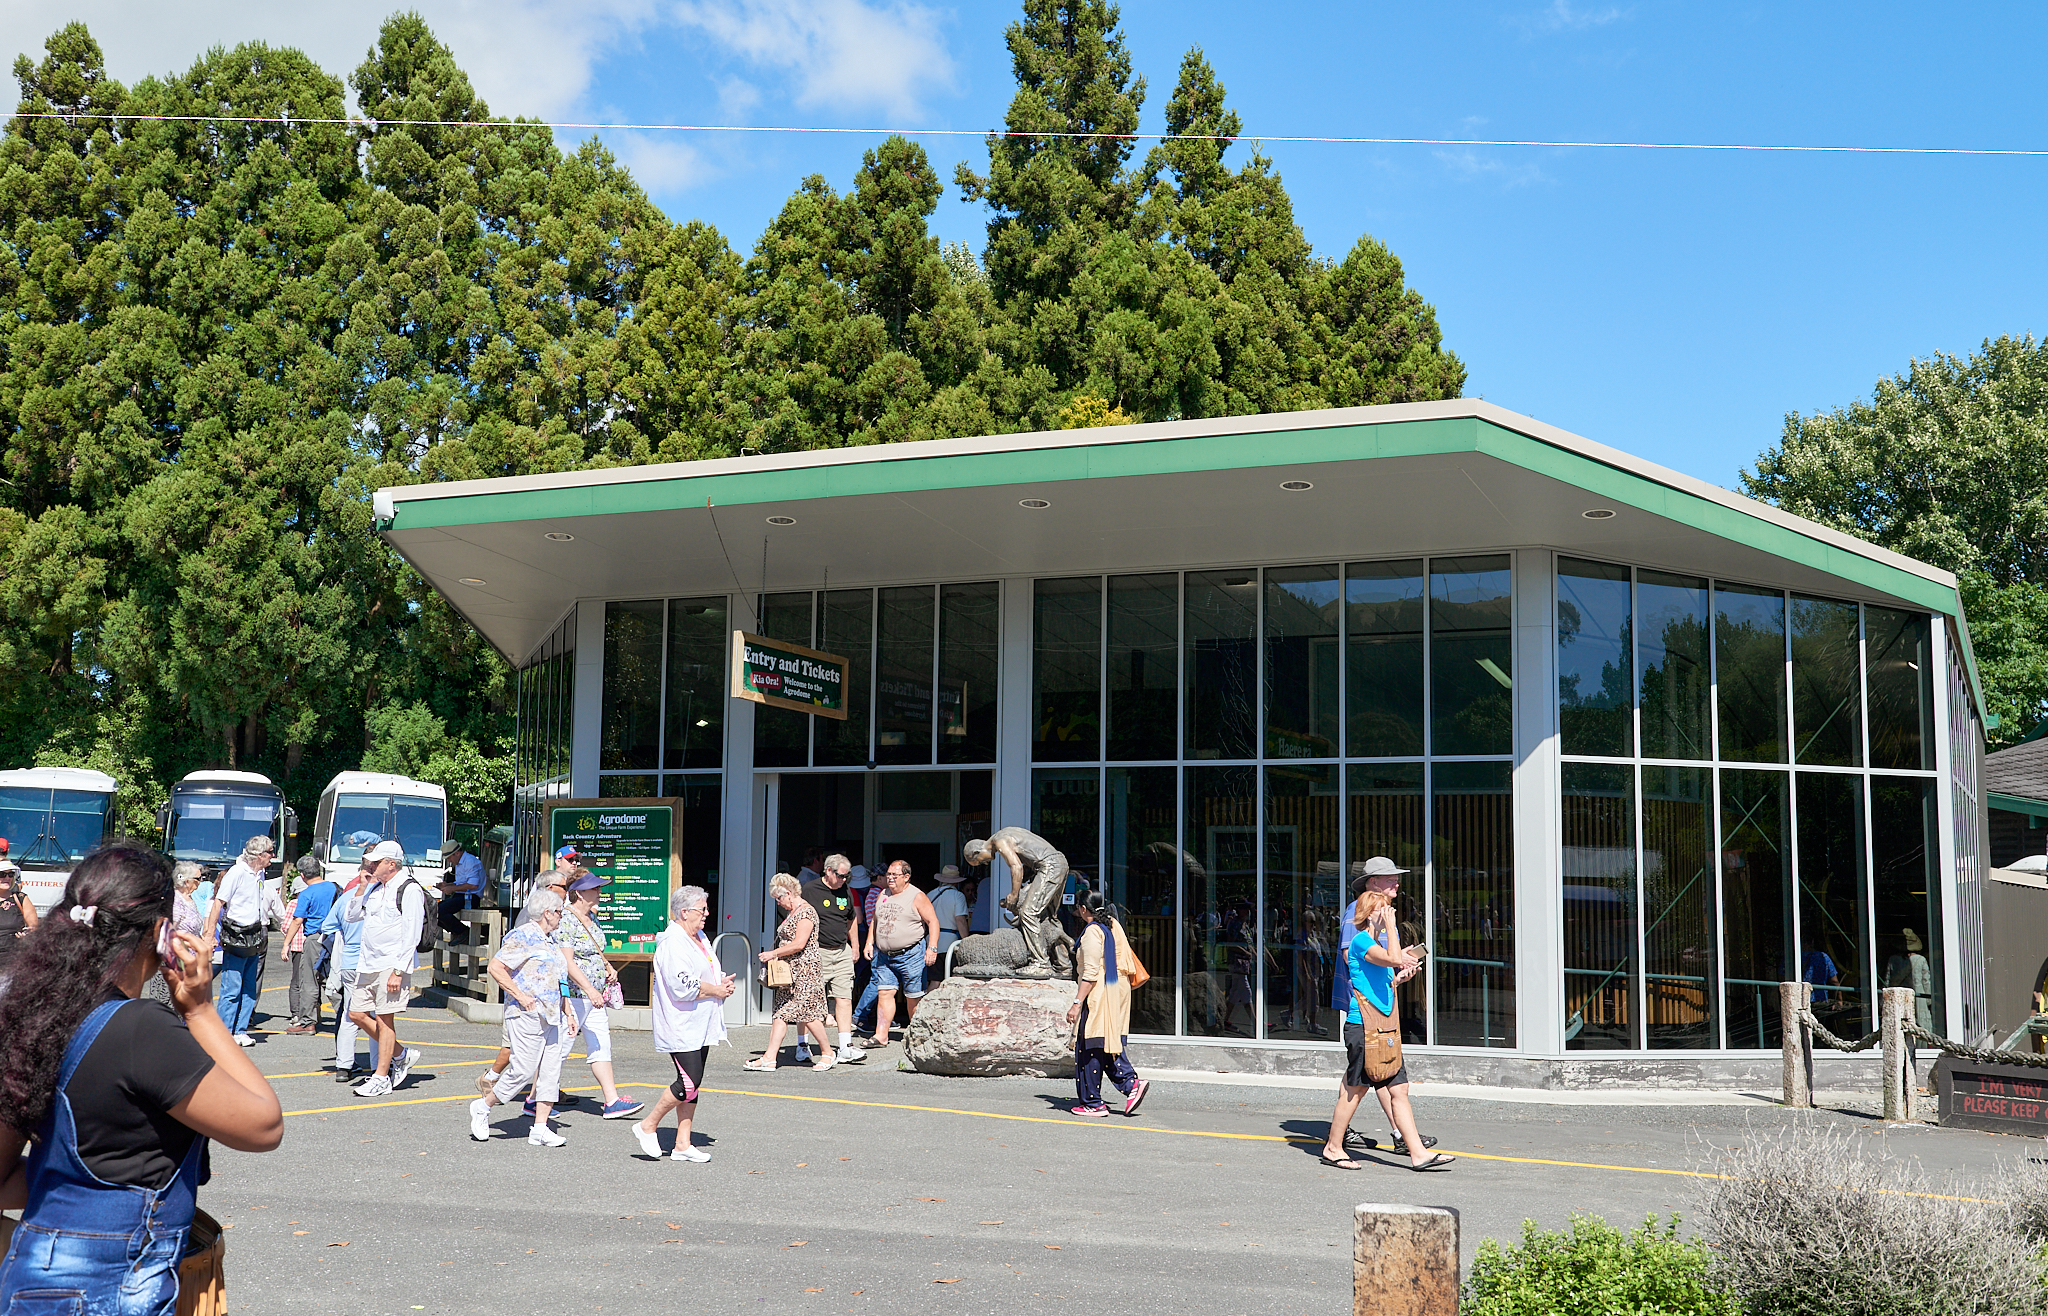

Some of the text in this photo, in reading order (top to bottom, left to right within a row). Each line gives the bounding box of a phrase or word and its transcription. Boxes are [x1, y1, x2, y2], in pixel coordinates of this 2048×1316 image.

[743, 645, 841, 684] Entry and Tickets
[753, 673, 779, 686] Kia Ora!
[783, 676, 823, 692] Welcome to the
[783, 686, 811, 699] Agrodome
[1278, 737, 1302, 758] Haere
[598, 814, 646, 826] Agrodome
[1978, 1076, 2042, 1098] I'M VERY
[1964, 1096, 2008, 1116] PLEASE
[2011, 1101, 2040, 1118] KEEP
